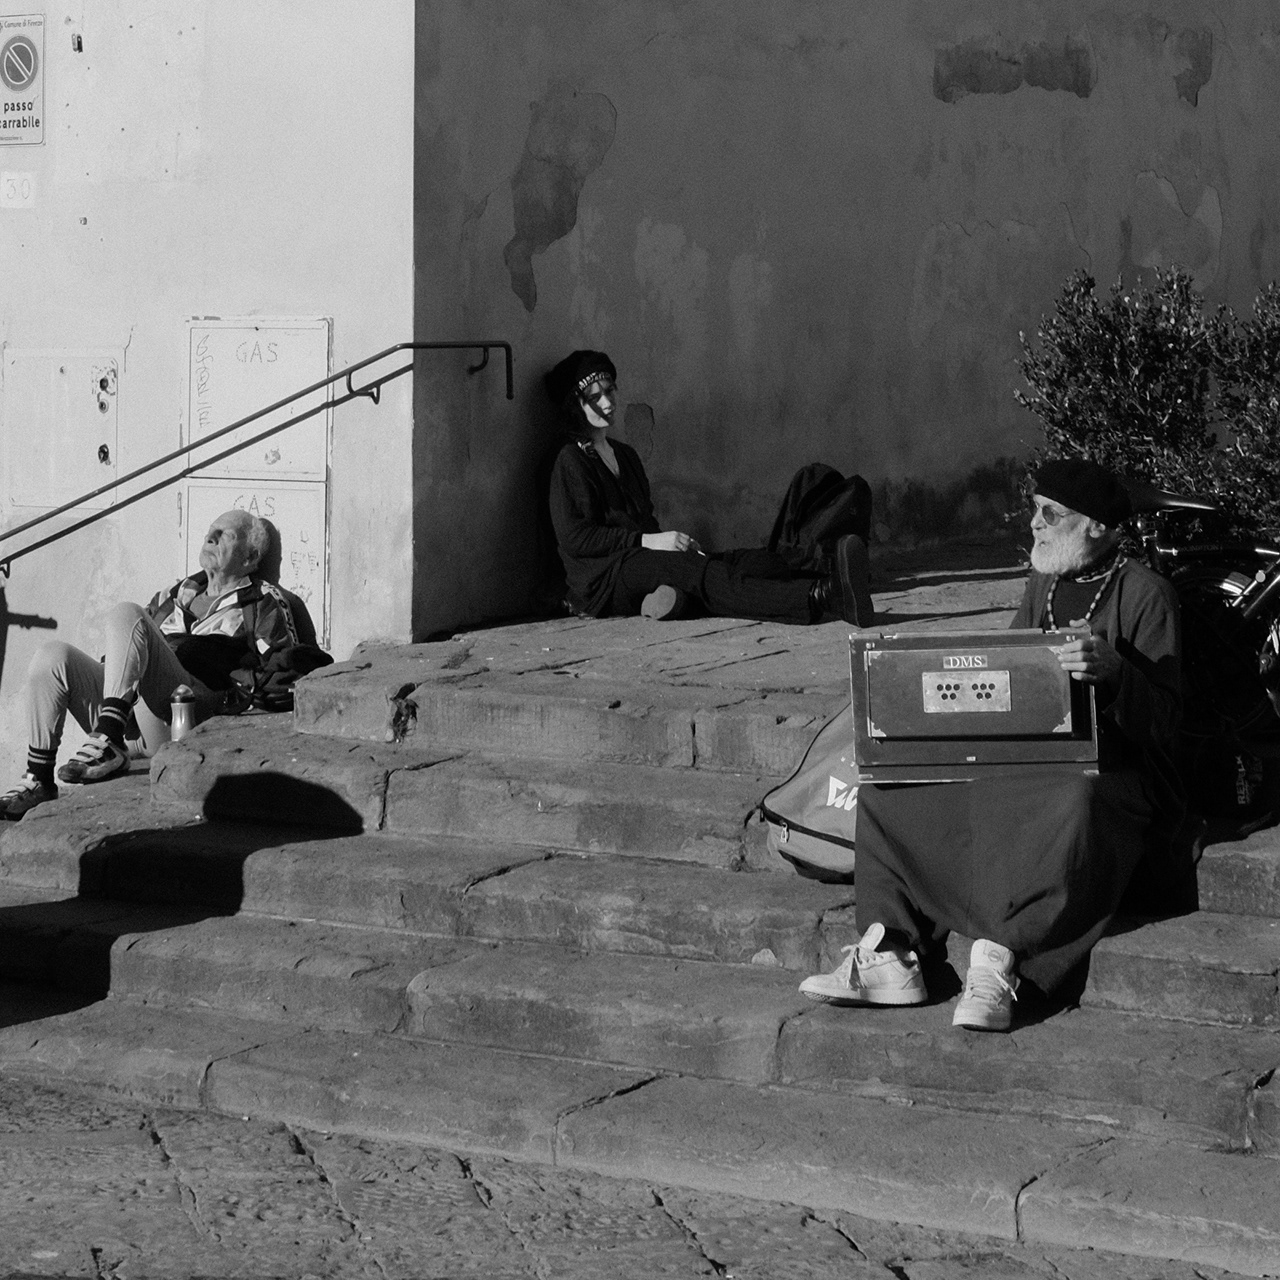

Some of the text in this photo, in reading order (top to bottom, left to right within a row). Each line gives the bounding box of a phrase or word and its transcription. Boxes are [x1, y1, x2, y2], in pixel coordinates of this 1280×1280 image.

[3, 100, 33, 114] passo
[6, 177, 31, 200] 30
[235, 340, 278, 363] GAS
[948, 655, 983, 668] DMS
